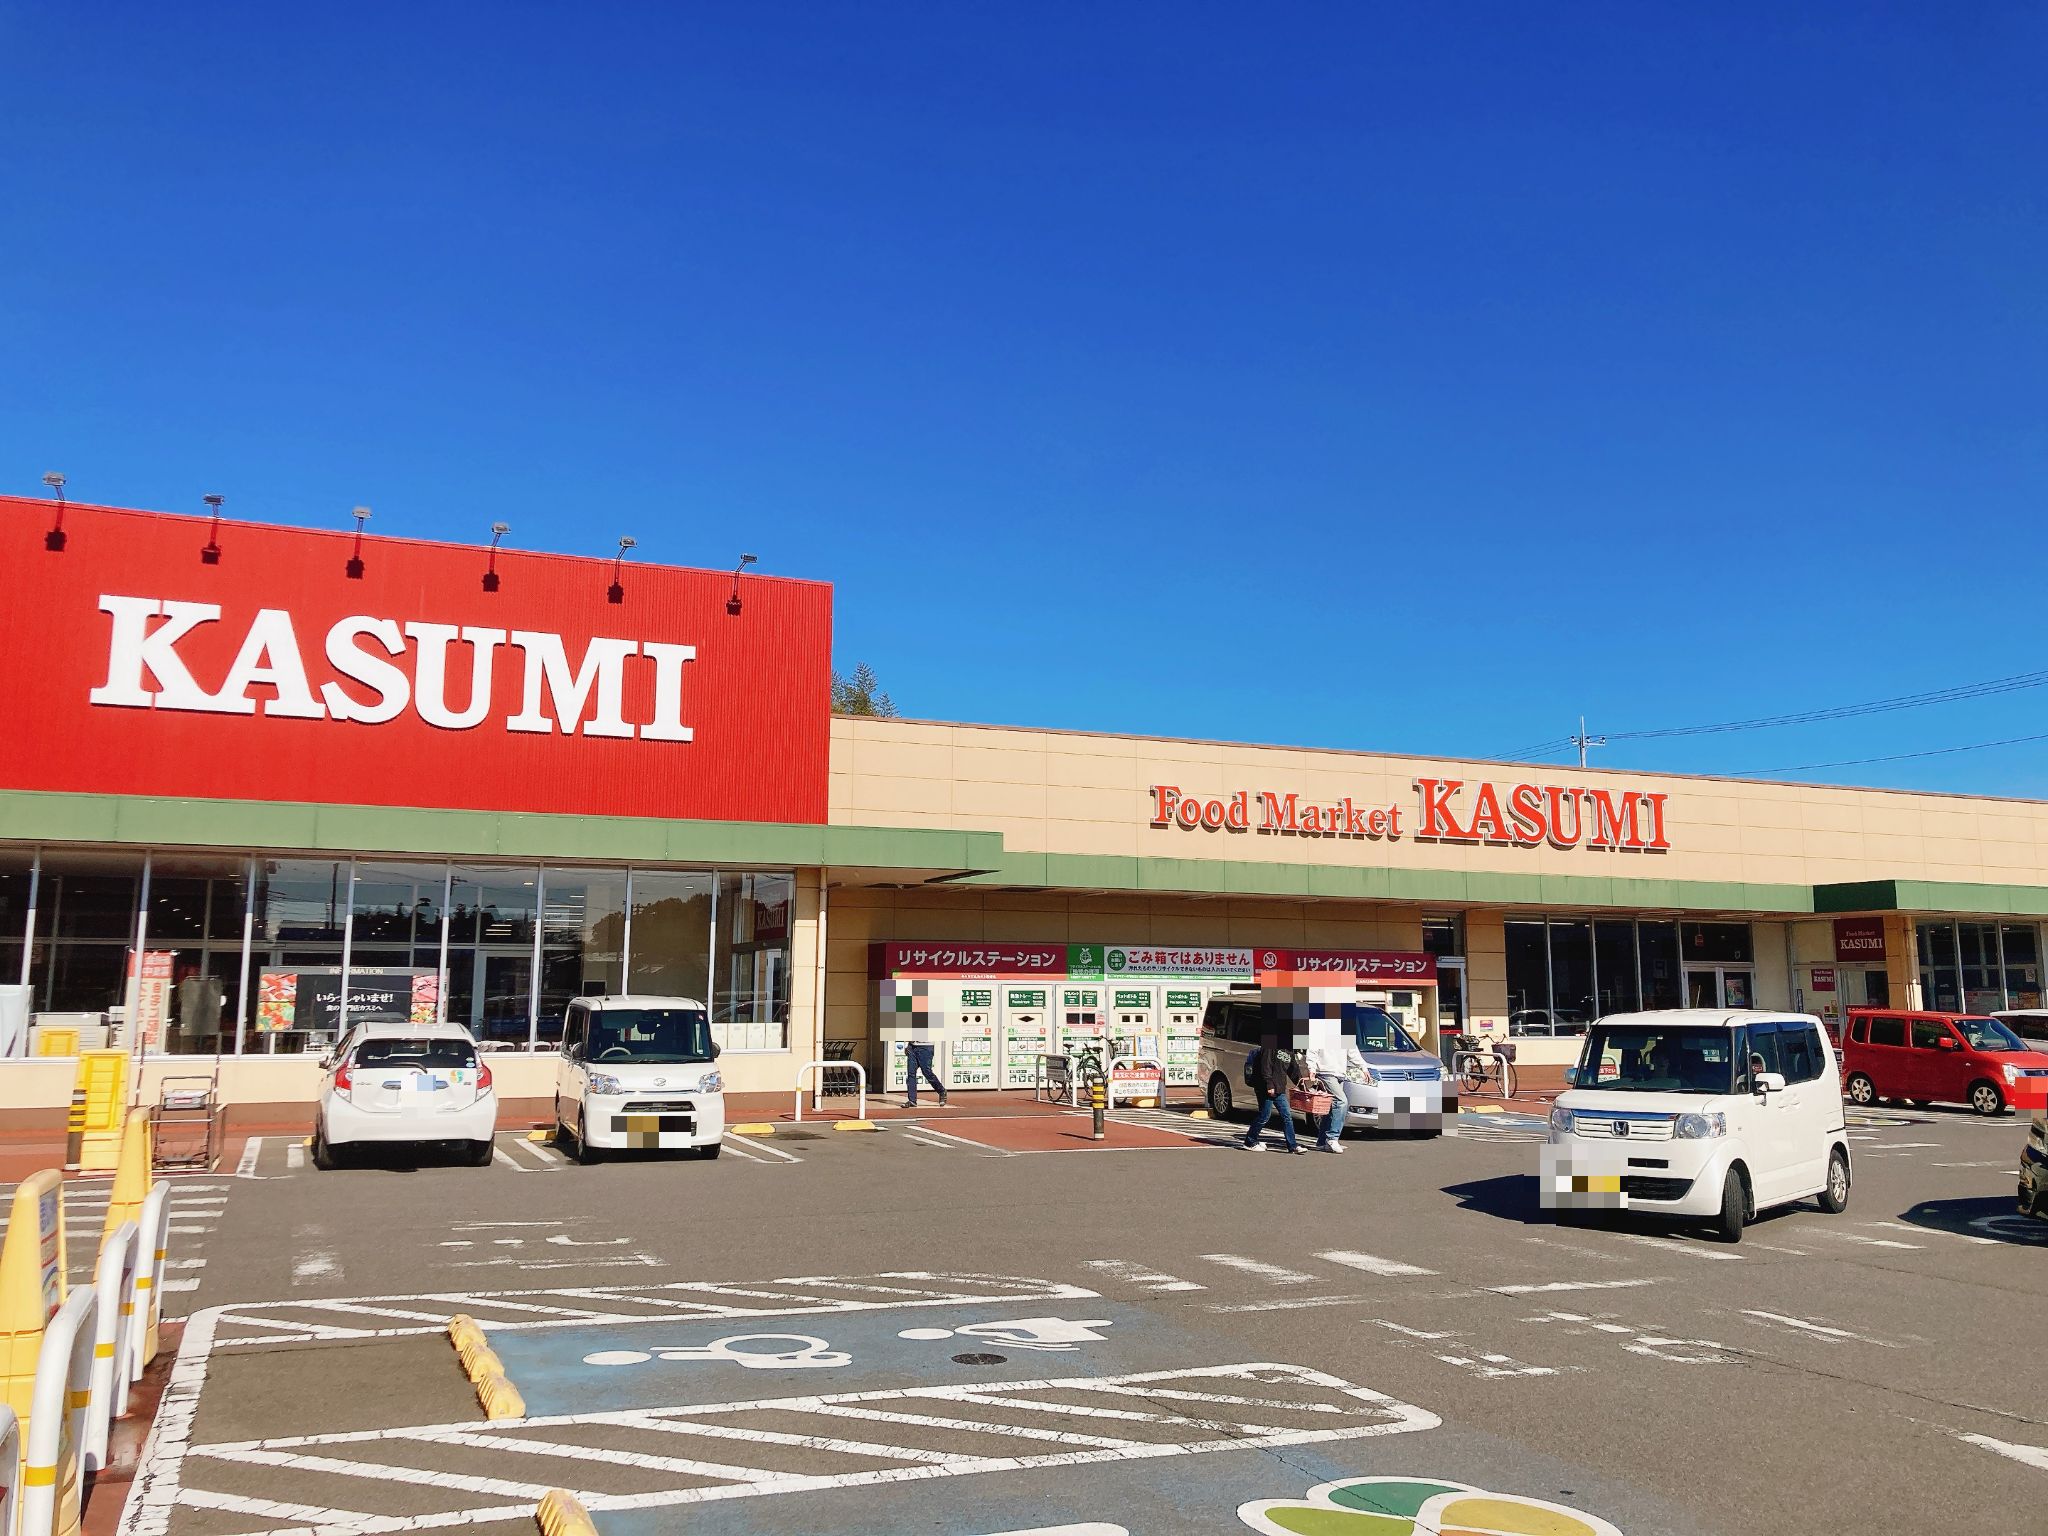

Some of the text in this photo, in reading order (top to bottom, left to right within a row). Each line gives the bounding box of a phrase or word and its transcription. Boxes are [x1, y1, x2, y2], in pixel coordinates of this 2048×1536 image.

[89, 594, 697, 743] KASUMI
[1150, 777, 1672, 850] Food Market KASUMI
[1840, 938, 1883, 950] KASUMI
[899, 950, 1056, 967] リサイクルステーション
[1129, 951, 1250, 966] ごみ箱ではありません
[1297, 957, 1427, 973] リサイクルステーション
[329, 967, 384, 975] INFRMATION
[326, 1004, 383, 1012] 食の門店カスミへ
